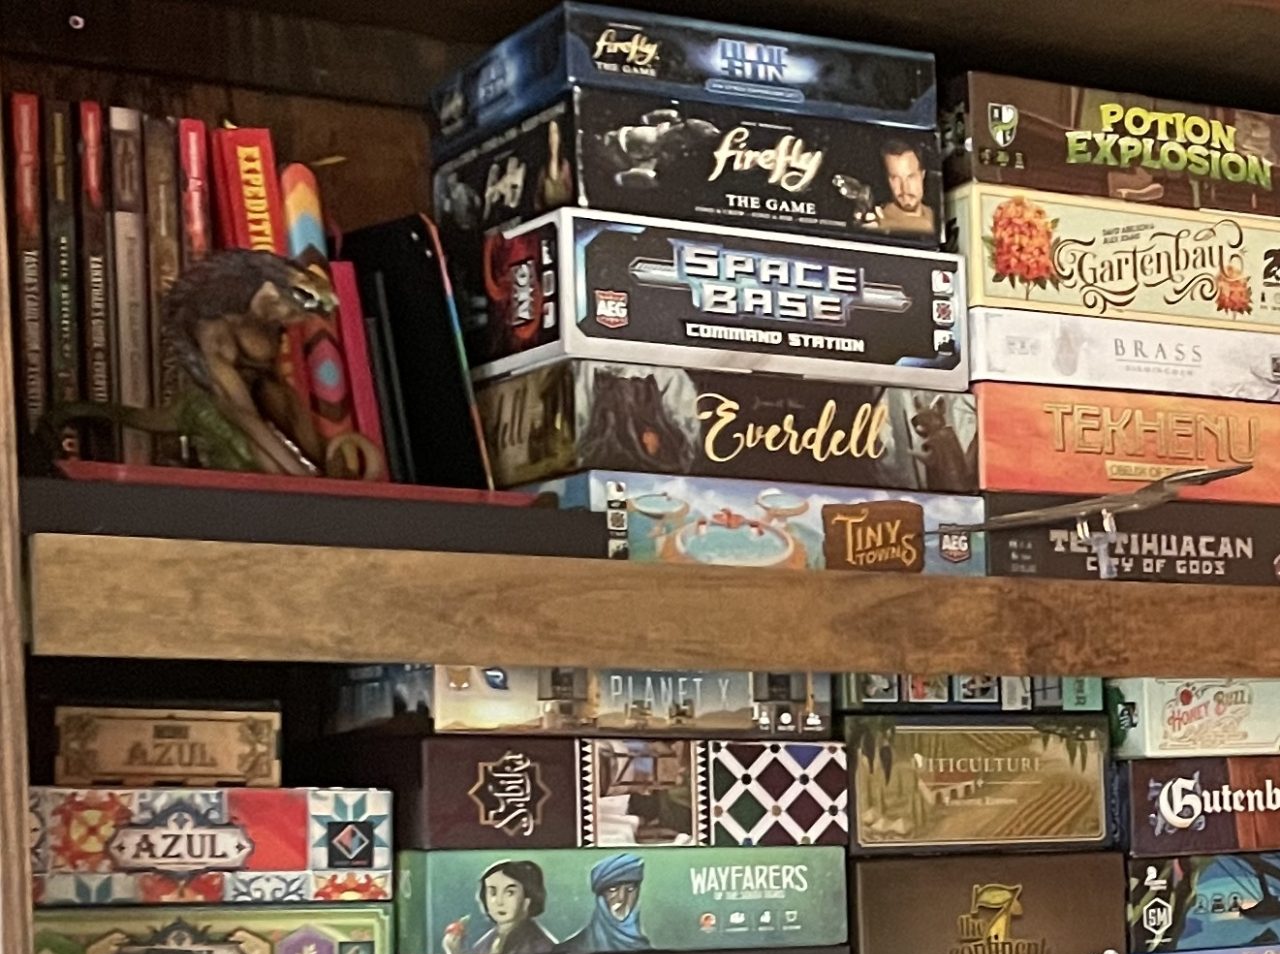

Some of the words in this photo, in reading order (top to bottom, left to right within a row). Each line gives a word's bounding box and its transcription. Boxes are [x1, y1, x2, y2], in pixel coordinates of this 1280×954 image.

[1099, 103, 1238, 152] POTION
[708, 126, 825, 193] firefly
[1065, 131, 1274, 191] EXPLOSION
[725, 193, 760, 213] THE
[764, 197, 817, 217] GAME
[682, 242, 864, 294] SPACE
[595, 297, 628, 318] AEG
[701, 282, 848, 323] BASE
[685, 322, 784, 347] COMMAND
[787, 331, 866, 354] STATION
[1113, 337, 1204, 363] BRASS
[694, 392, 890, 463] Everdell
[1043, 401, 1259, 464] TEKHENU
[834, 507, 903, 566] TINY
[941, 532, 969, 550] AEG
[1049, 529, 1254, 561] TETIHUACAN
[1143, 558, 1166, 573] OF
[1175, 560, 1226, 576] GODS
[610, 674, 704, 708] PLANET
[717, 678, 729, 700] X
[126, 741, 219, 769] AZUL
[912, 754, 1043, 774] VITICULTURE
[132, 832, 229, 860] AZUL
[690, 864, 809, 895] WAYFARERS
